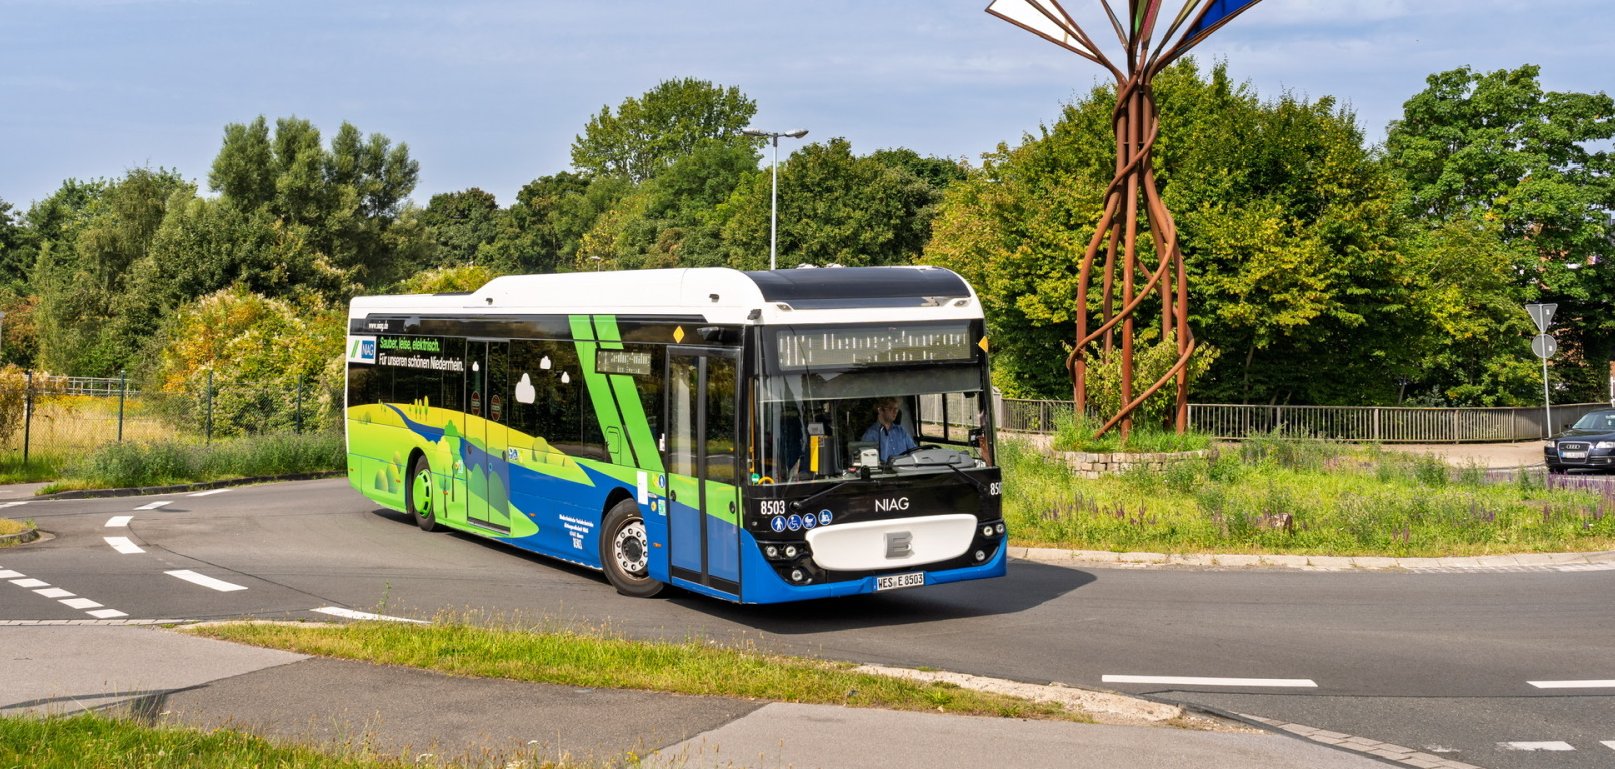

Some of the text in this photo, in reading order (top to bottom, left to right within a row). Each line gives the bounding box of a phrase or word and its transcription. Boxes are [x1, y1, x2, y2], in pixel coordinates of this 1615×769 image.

[362, 343, 374, 356] NIAG
[412, 338, 440, 351] elektrisch.
[379, 353, 464, 372] Für unseren schönen Niederrhein.
[760, 500, 786, 515] 8503
[874, 496, 910, 512] NIAG
[877, 573, 923, 589] WES E 8503
